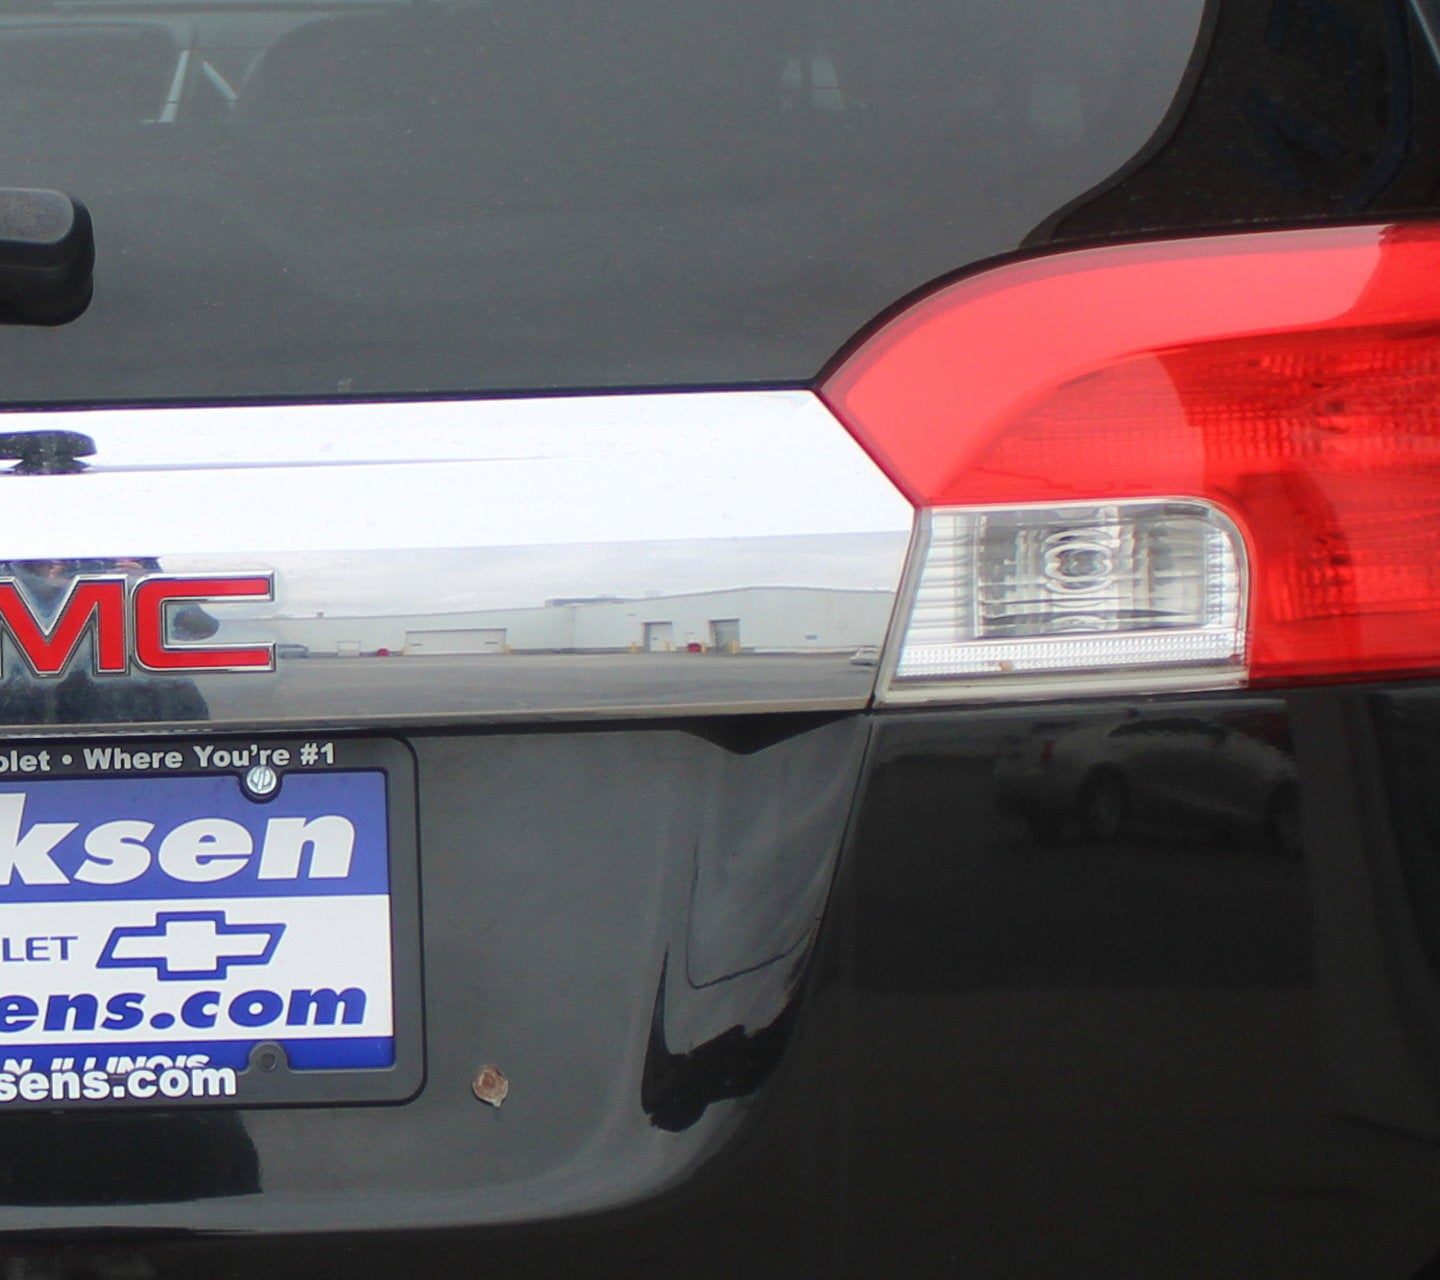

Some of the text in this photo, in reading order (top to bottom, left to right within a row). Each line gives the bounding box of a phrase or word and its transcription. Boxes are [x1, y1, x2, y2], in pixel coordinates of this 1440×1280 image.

[83, 747, 183, 770] Where
[193, 744, 291, 768] You're
[300, 742, 335, 765] #1
